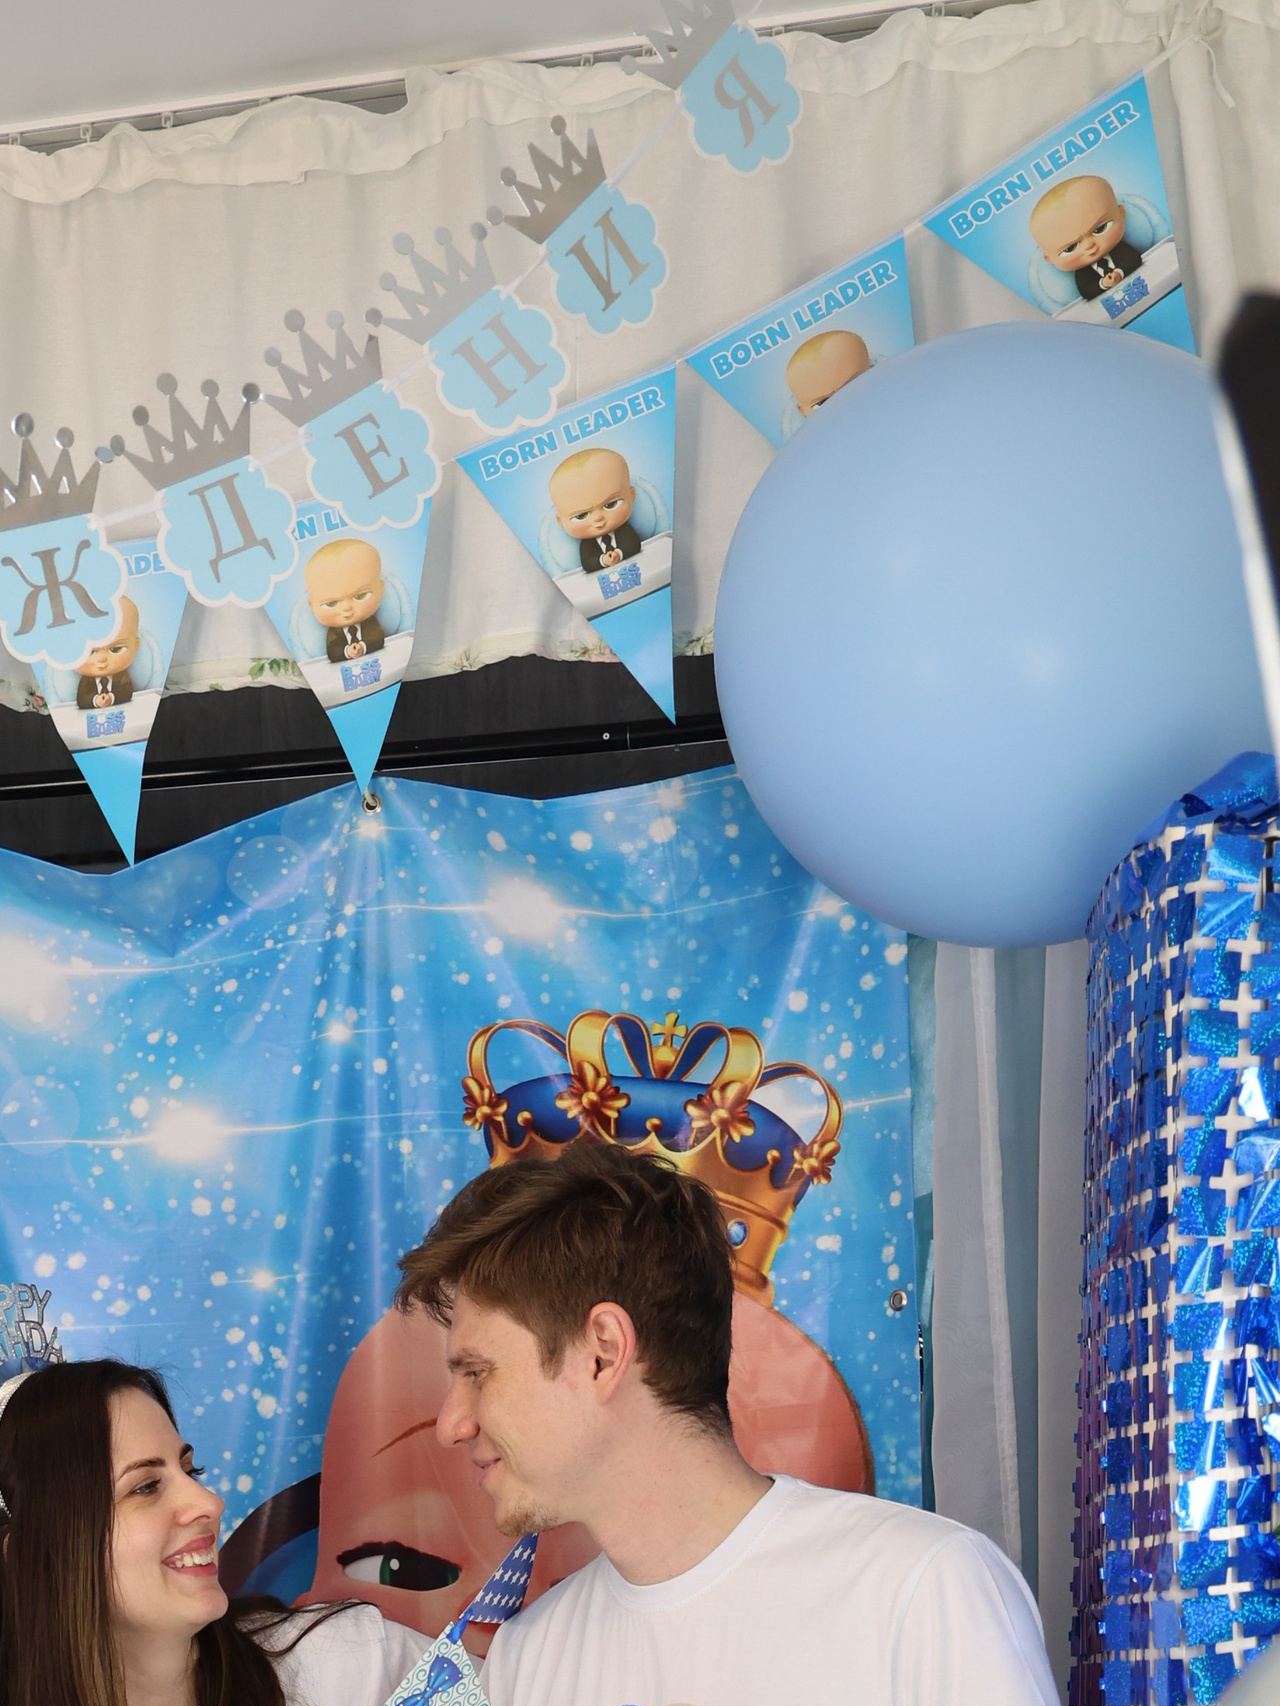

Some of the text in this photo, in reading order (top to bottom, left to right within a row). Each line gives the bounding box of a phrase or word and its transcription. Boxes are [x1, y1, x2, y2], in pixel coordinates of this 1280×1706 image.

[949, 100, 1140, 238] BORN LEADER
[711, 261, 897, 378] BORN LEADER
[481, 388, 664, 480] BORN LEADER
